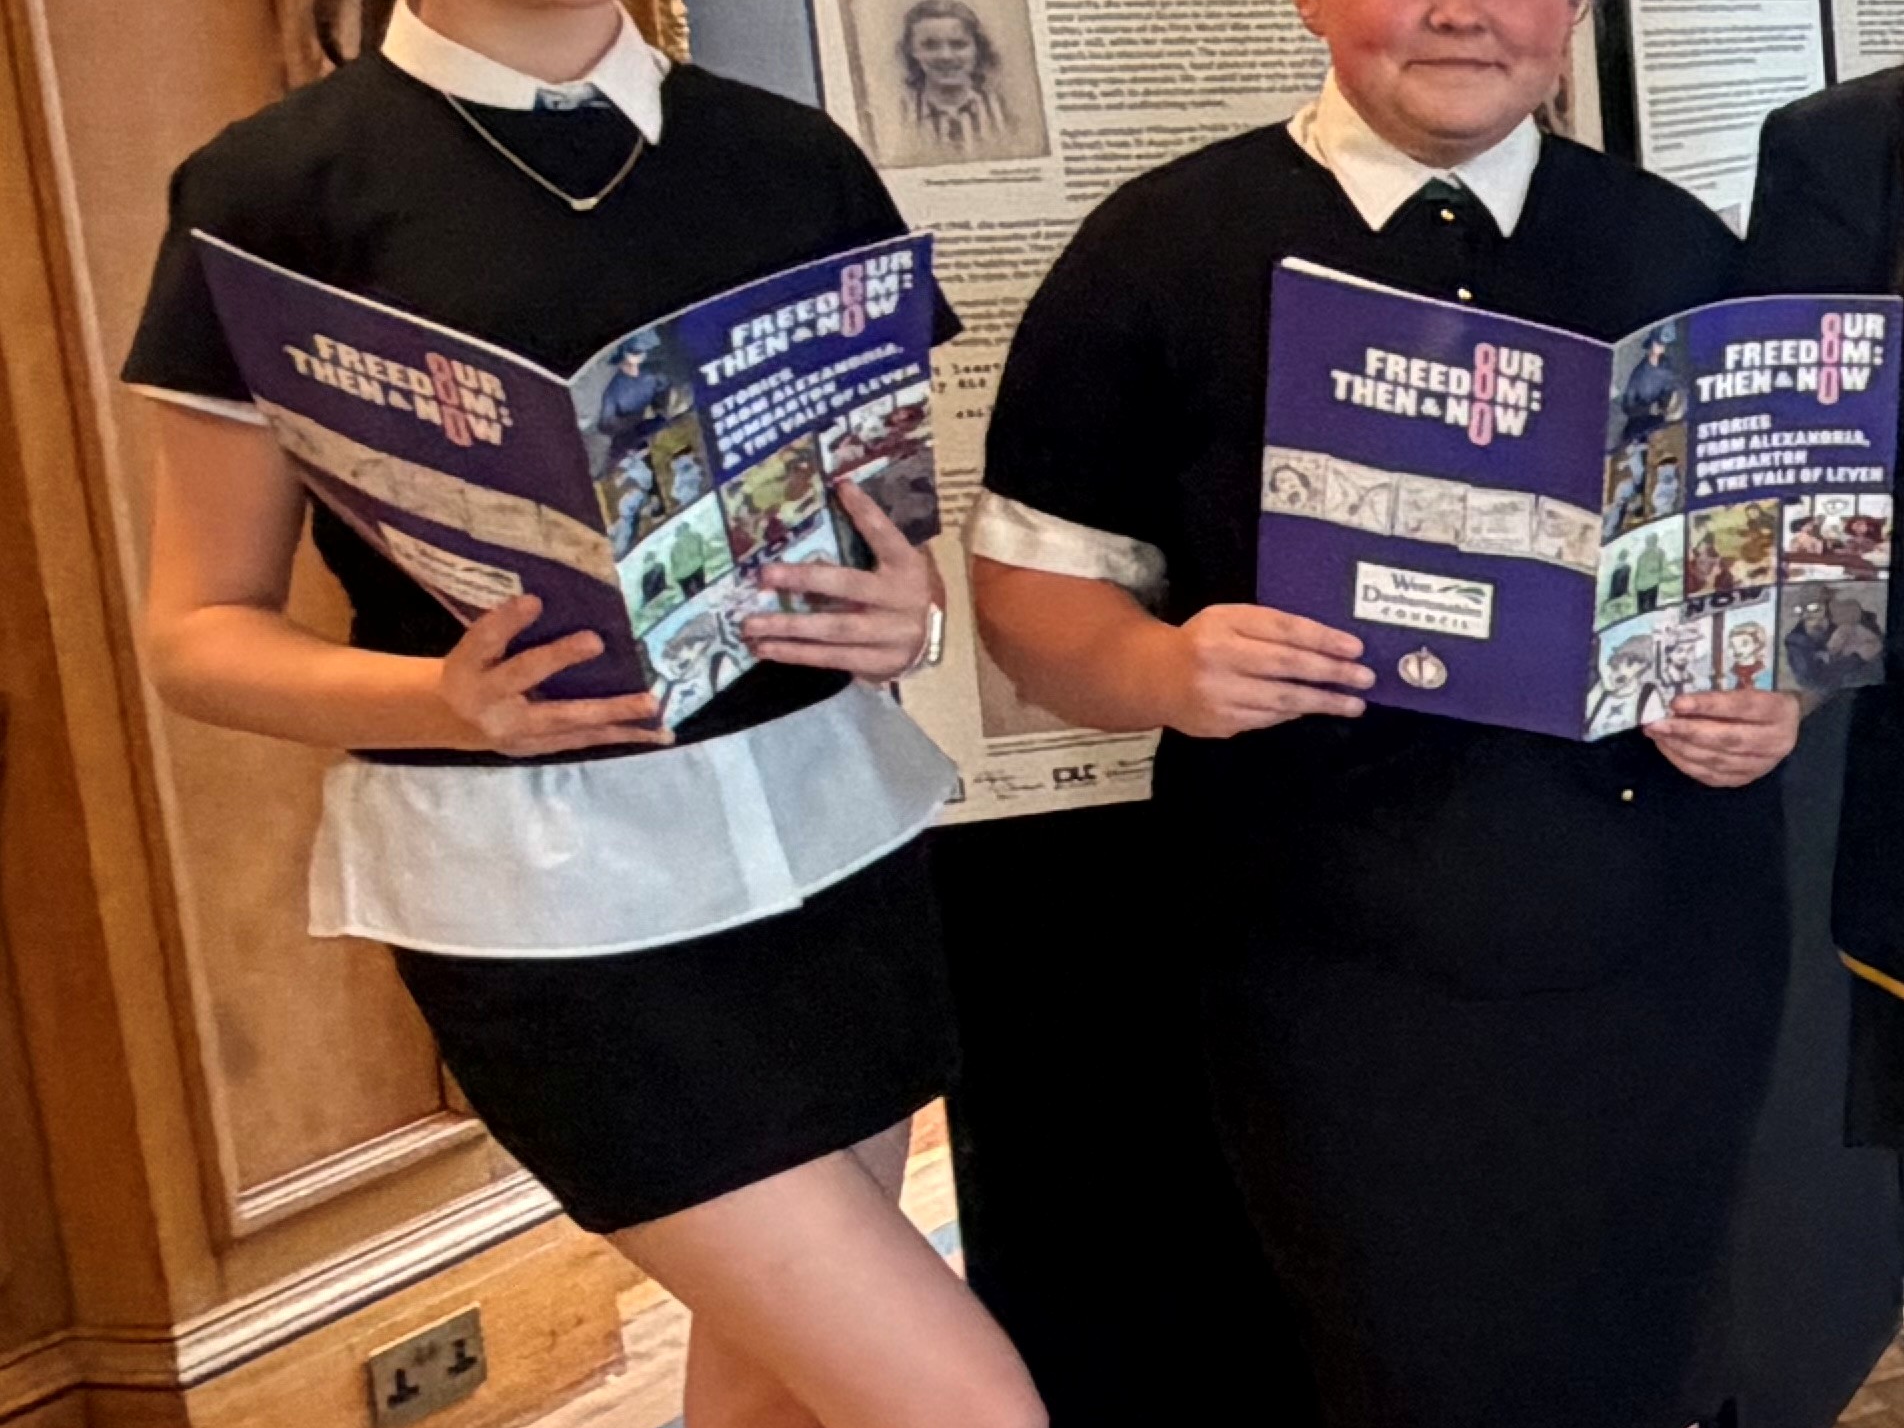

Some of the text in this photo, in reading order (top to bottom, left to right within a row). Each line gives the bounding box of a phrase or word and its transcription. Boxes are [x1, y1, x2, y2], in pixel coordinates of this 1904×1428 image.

[841, 250, 913, 282] OUR
[698, 333, 790, 385] THEN
[816, 294, 900, 337] NOW
[1821, 312, 1886, 339] OUR
[425, 352, 506, 402] OUR
[1474, 342, 1544, 384] OUR
[1724, 338, 1884, 370] FREEDOM:
[282, 344, 385, 406] THEN
[413, 394, 502, 447] NOW
[1365, 346, 1542, 412] FREEDOM:
[1695, 366, 1871, 405] THEN & NOW
[1330, 368, 1528, 446] THEN & NOW
